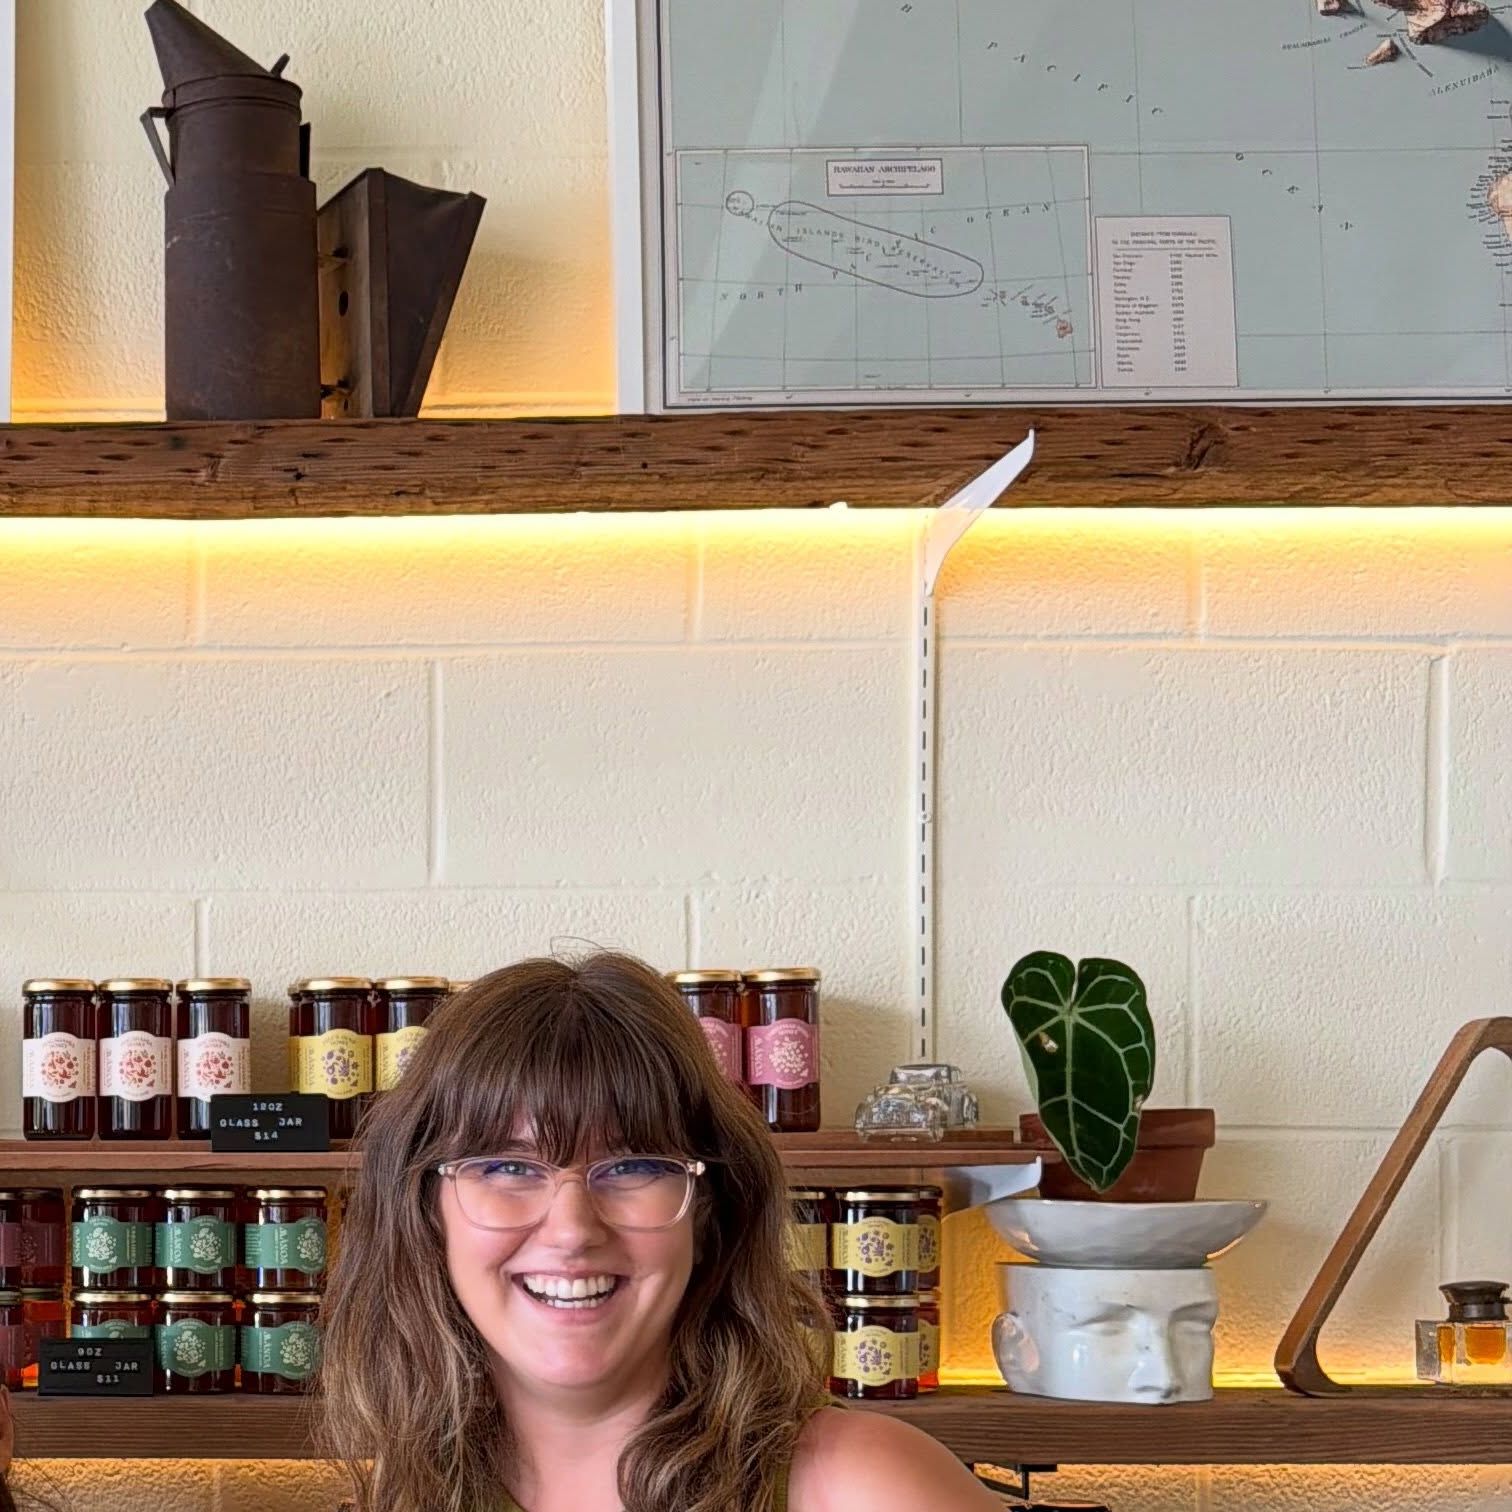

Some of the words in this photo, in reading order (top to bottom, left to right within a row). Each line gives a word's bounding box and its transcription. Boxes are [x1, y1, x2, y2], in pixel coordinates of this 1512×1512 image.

[219, 1118, 259, 1128] GLASS
[279, 1117, 303, 1127] JAR
[254, 1131, 278, 1141] $14
[50, 1361, 91, 1371] GLASS
[115, 1361, 138, 1371] JAR
[96, 1374, 120, 1384] $11
